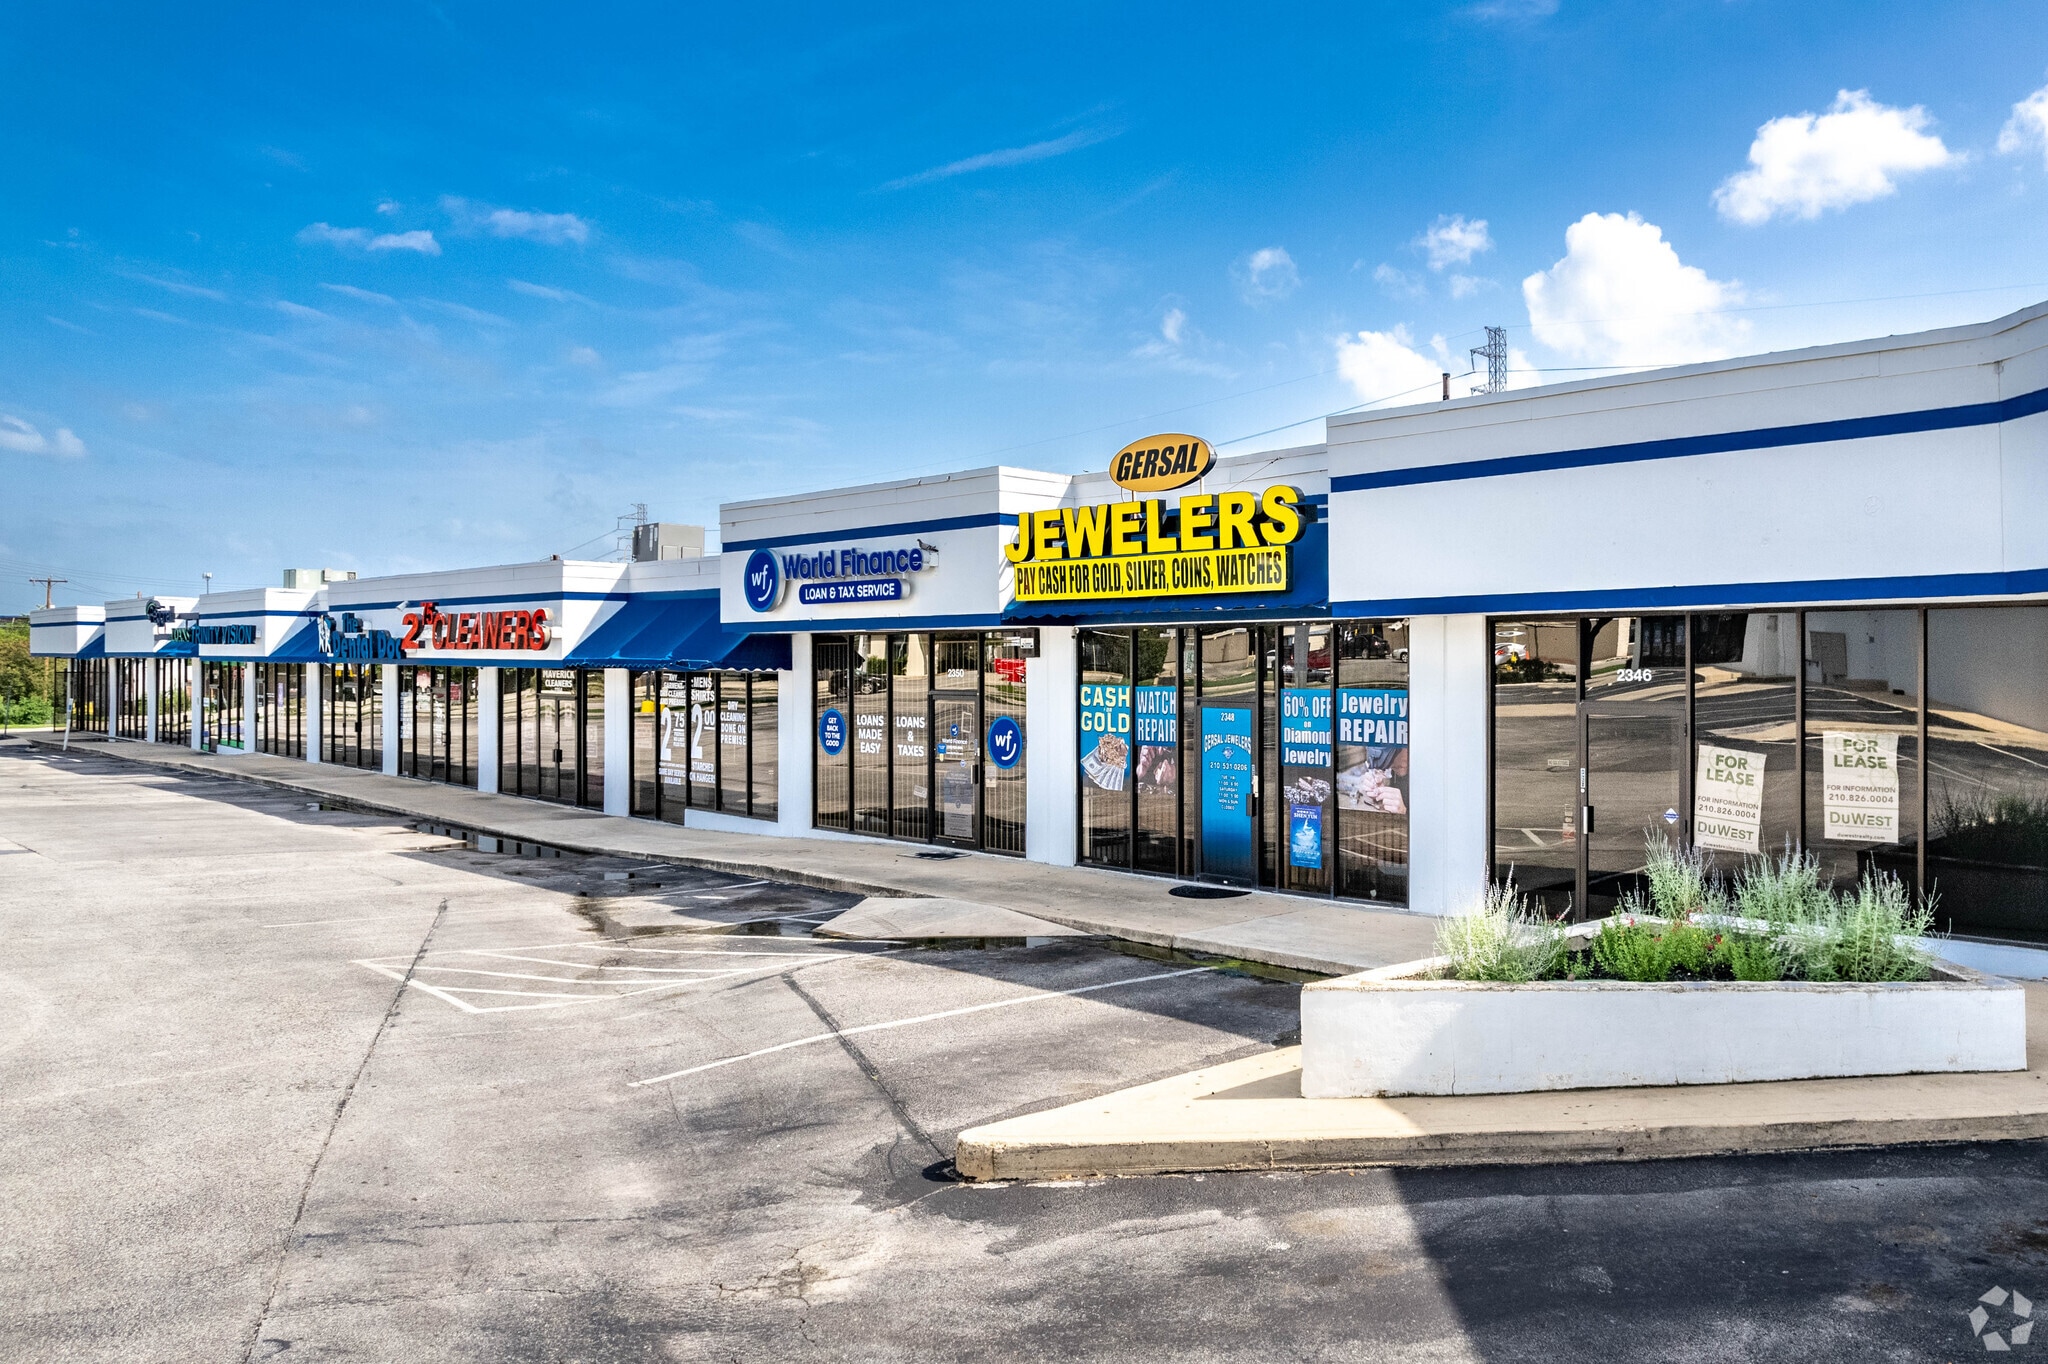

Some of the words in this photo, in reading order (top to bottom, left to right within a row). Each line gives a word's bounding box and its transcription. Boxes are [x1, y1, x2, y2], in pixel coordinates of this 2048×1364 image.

[1116, 442, 1199, 483] GERSAL
[1004, 485, 1300, 562] JEWELERS
[782, 550, 835, 580] World
[841, 547, 923, 577] Finance
[1016, 567, 1036, 595] PAY
[1039, 565, 1067, 595] CASH
[1069, 564, 1090, 593] FOR
[1092, 563, 1124, 594] GOLD,
[1126, 558, 1169, 592] SILVER,
[1172, 556, 1213, 590] COINS,
[1216, 551, 1282, 587] WATCHES
[805, 587, 828, 600] LOAN
[829, 588, 836, 598] &
[838, 586, 855, 598] TAX
[857, 583, 895, 597] SERVICE
[342, 613, 359, 633] The
[432, 608, 550, 651] CLEANERS
[191, 625, 220, 644] TRINITY
[222, 625, 252, 644] VISION
[332, 630, 372, 659] Dental
[543, 670, 575, 679] MAVERICK
[947, 669, 965, 678] 2350
[1616, 668, 1652, 682] 2346
[545, 680, 572, 688] CLEANERS
[691, 689, 715, 702] SHIRTS
[1081, 686, 1130, 707] CASH
[1137, 691, 1176, 715] WATCH
[728, 701, 738, 711] DRY
[1284, 696, 1309, 718] 60%
[1313, 696, 1331, 718] OFF
[1340, 692, 1408, 717] Jewelry
[721, 712, 746, 722] CLEANING
[856, 714, 884, 726] LOANS
[896, 716, 925, 729] LOANS
[1081, 711, 1130, 733] GOLD
[1220, 712, 1235, 722] 2348
[721, 723, 736, 733] DONE
[737, 724, 746, 734] ON
[831, 732, 840, 740] THE
[858, 728, 883, 740] MADE
[1137, 718, 1176, 742] REPAIR
[1340, 718, 1408, 745] REPAIR
[721, 734, 747, 746] PREMISE
[907, 731, 914, 742] &
[995, 730, 1013, 752] wf
[1284, 728, 1331, 745] Diamond
[860, 742, 881, 754] EASY
[897, 744, 925, 757] TAXES
[1204, 734, 1223, 752] GERSAL
[1225, 734, 1252, 755] JEWELERS
[1843, 739, 1878, 753] FOR
[1284, 747, 1331, 767] Jewelry
[1715, 754, 1748, 770] FOR
[1834, 754, 1888, 769] LEASE
[1706, 768, 1755, 787] LEASE
[1843, 785, 1896, 793] INFORMATION
[1697, 795, 1711, 803] FOR
[1712, 797, 1759, 810] INFORMATION
[1829, 793, 1894, 803] 210.826.0004
[1698, 804, 1756, 819] 210.826.0004
